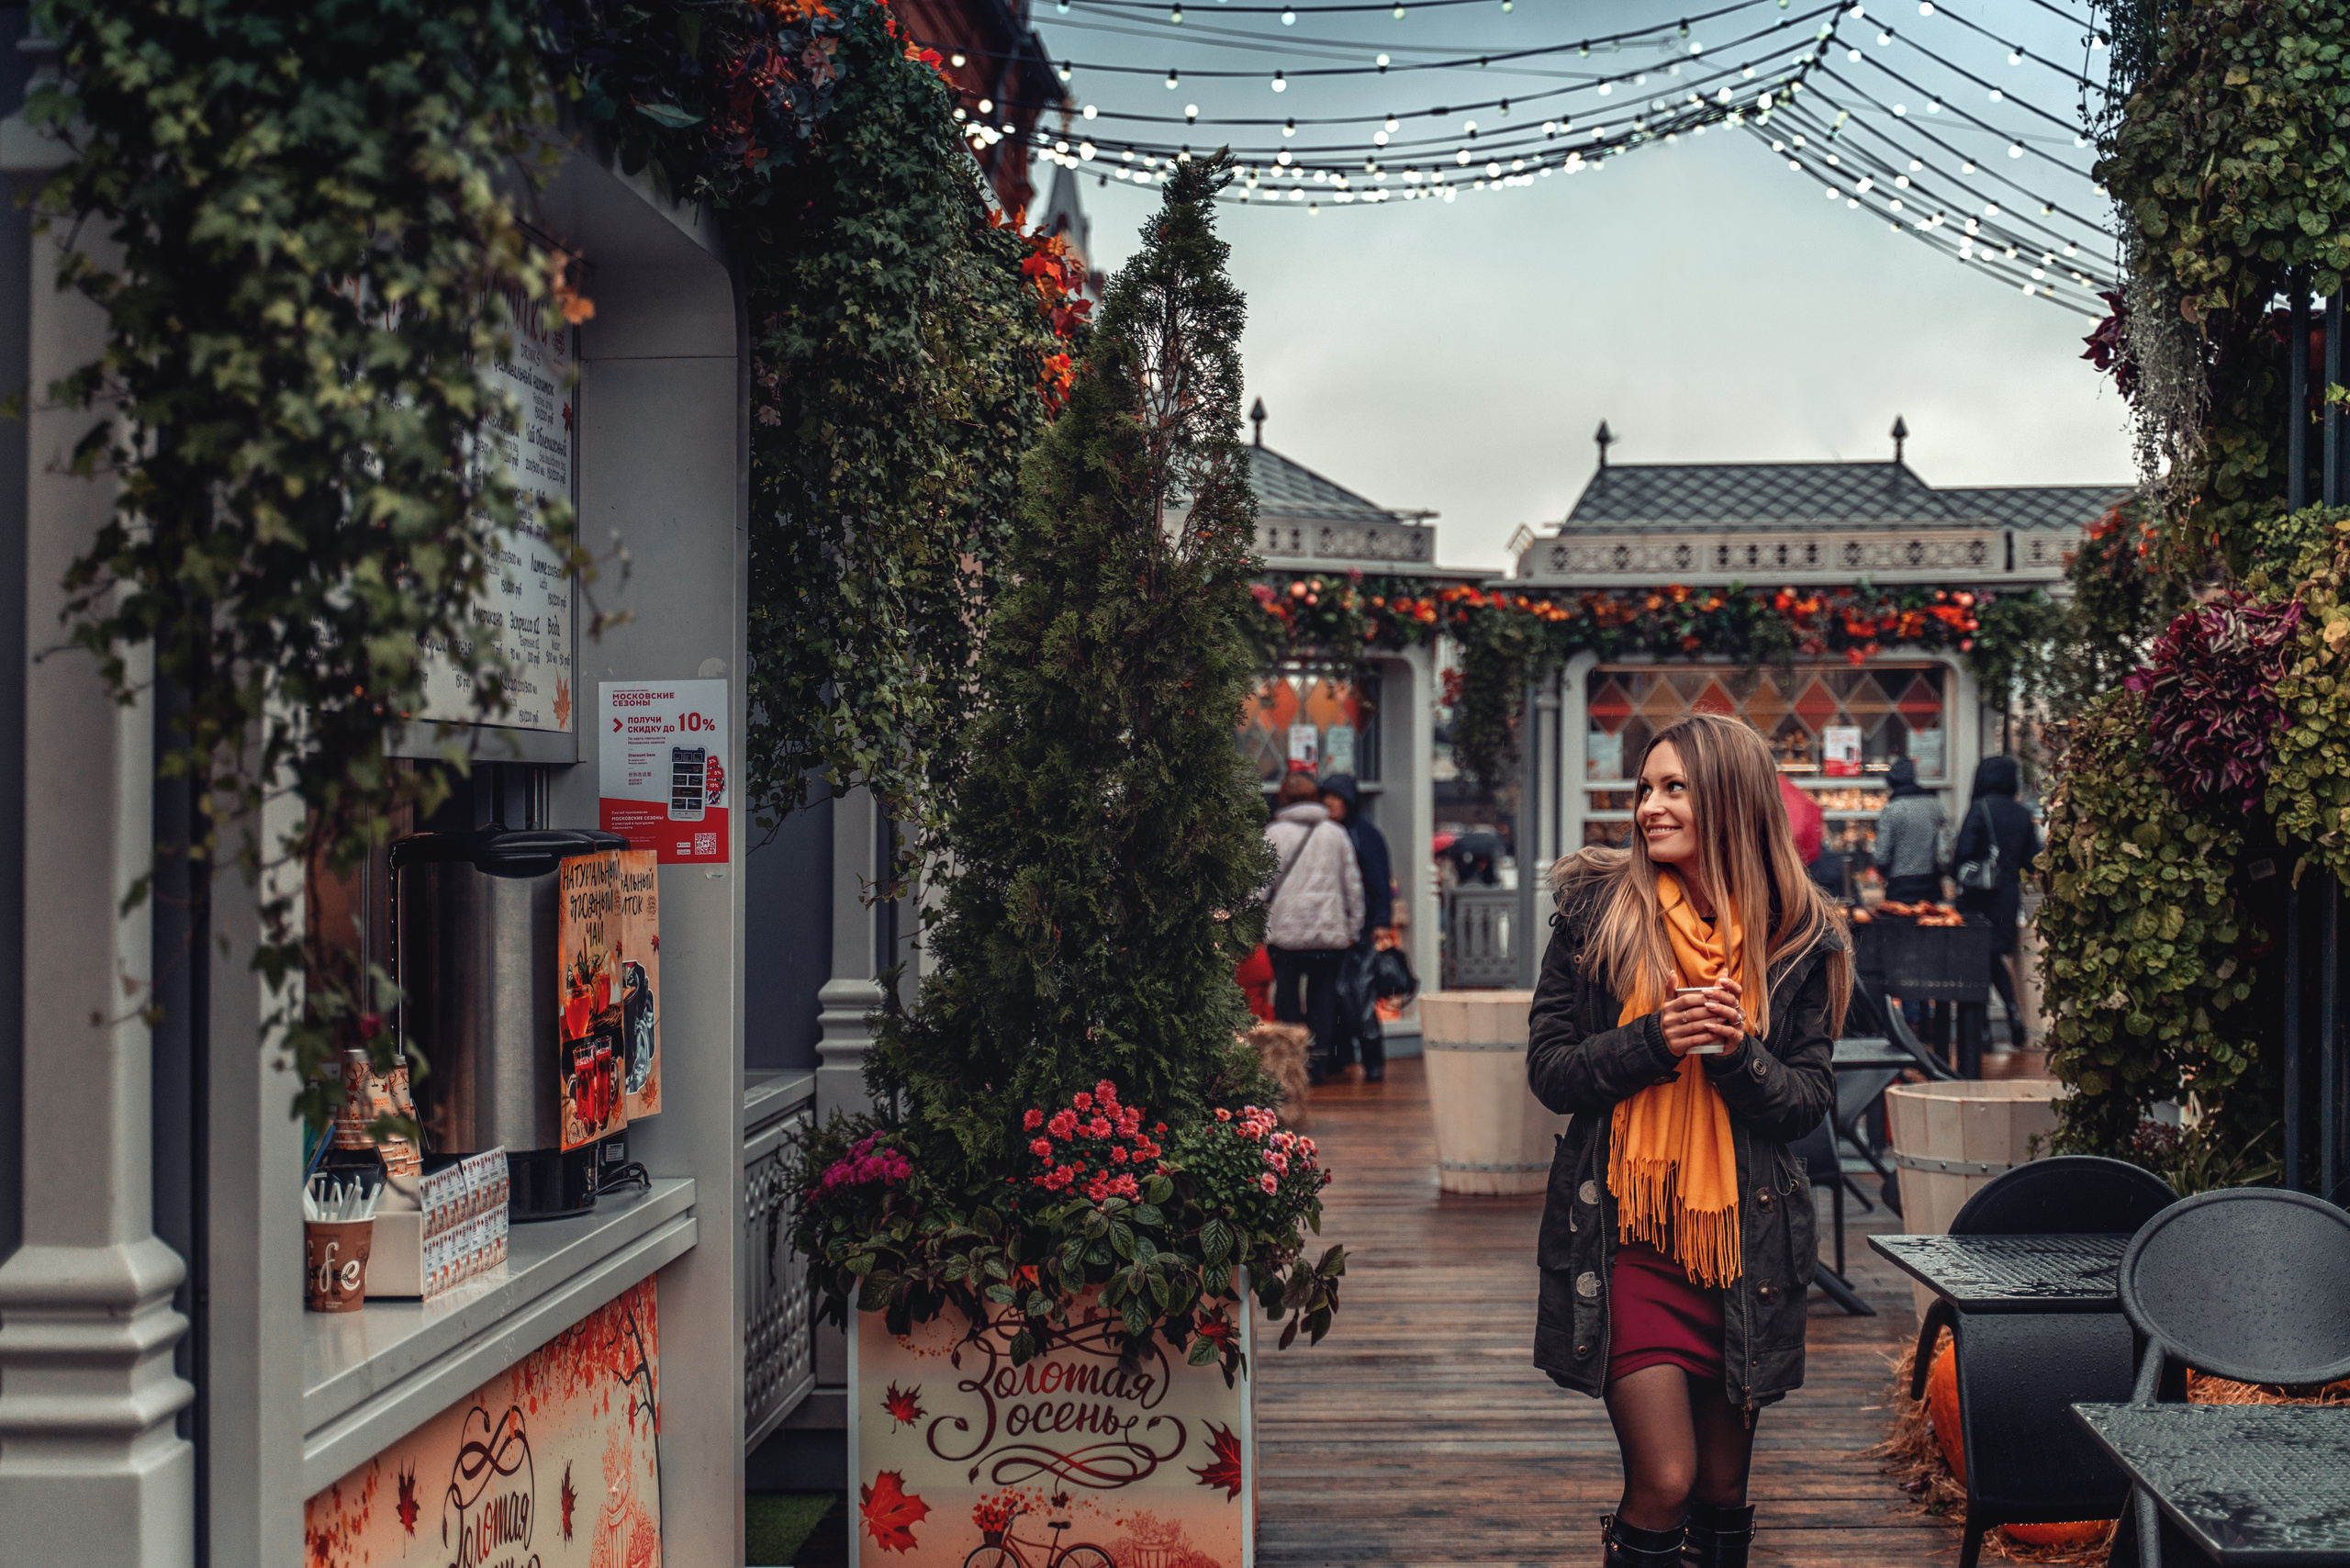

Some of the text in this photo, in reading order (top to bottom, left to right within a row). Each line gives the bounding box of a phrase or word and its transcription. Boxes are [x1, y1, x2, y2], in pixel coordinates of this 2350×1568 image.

[520, 343, 540, 366] DRINKS
[526, 422, 535, 443] Чай
[531, 553, 547, 575] Латте
[547, 614, 560, 637] Вода
[628, 716, 662, 724] ПОЛУЧИ
[628, 711, 716, 734] СКИДКУ ДО 10%
[563, 851, 621, 891] НАТУРАЛЬНЫЙ
[1005, 1400, 1137, 1438] осень
